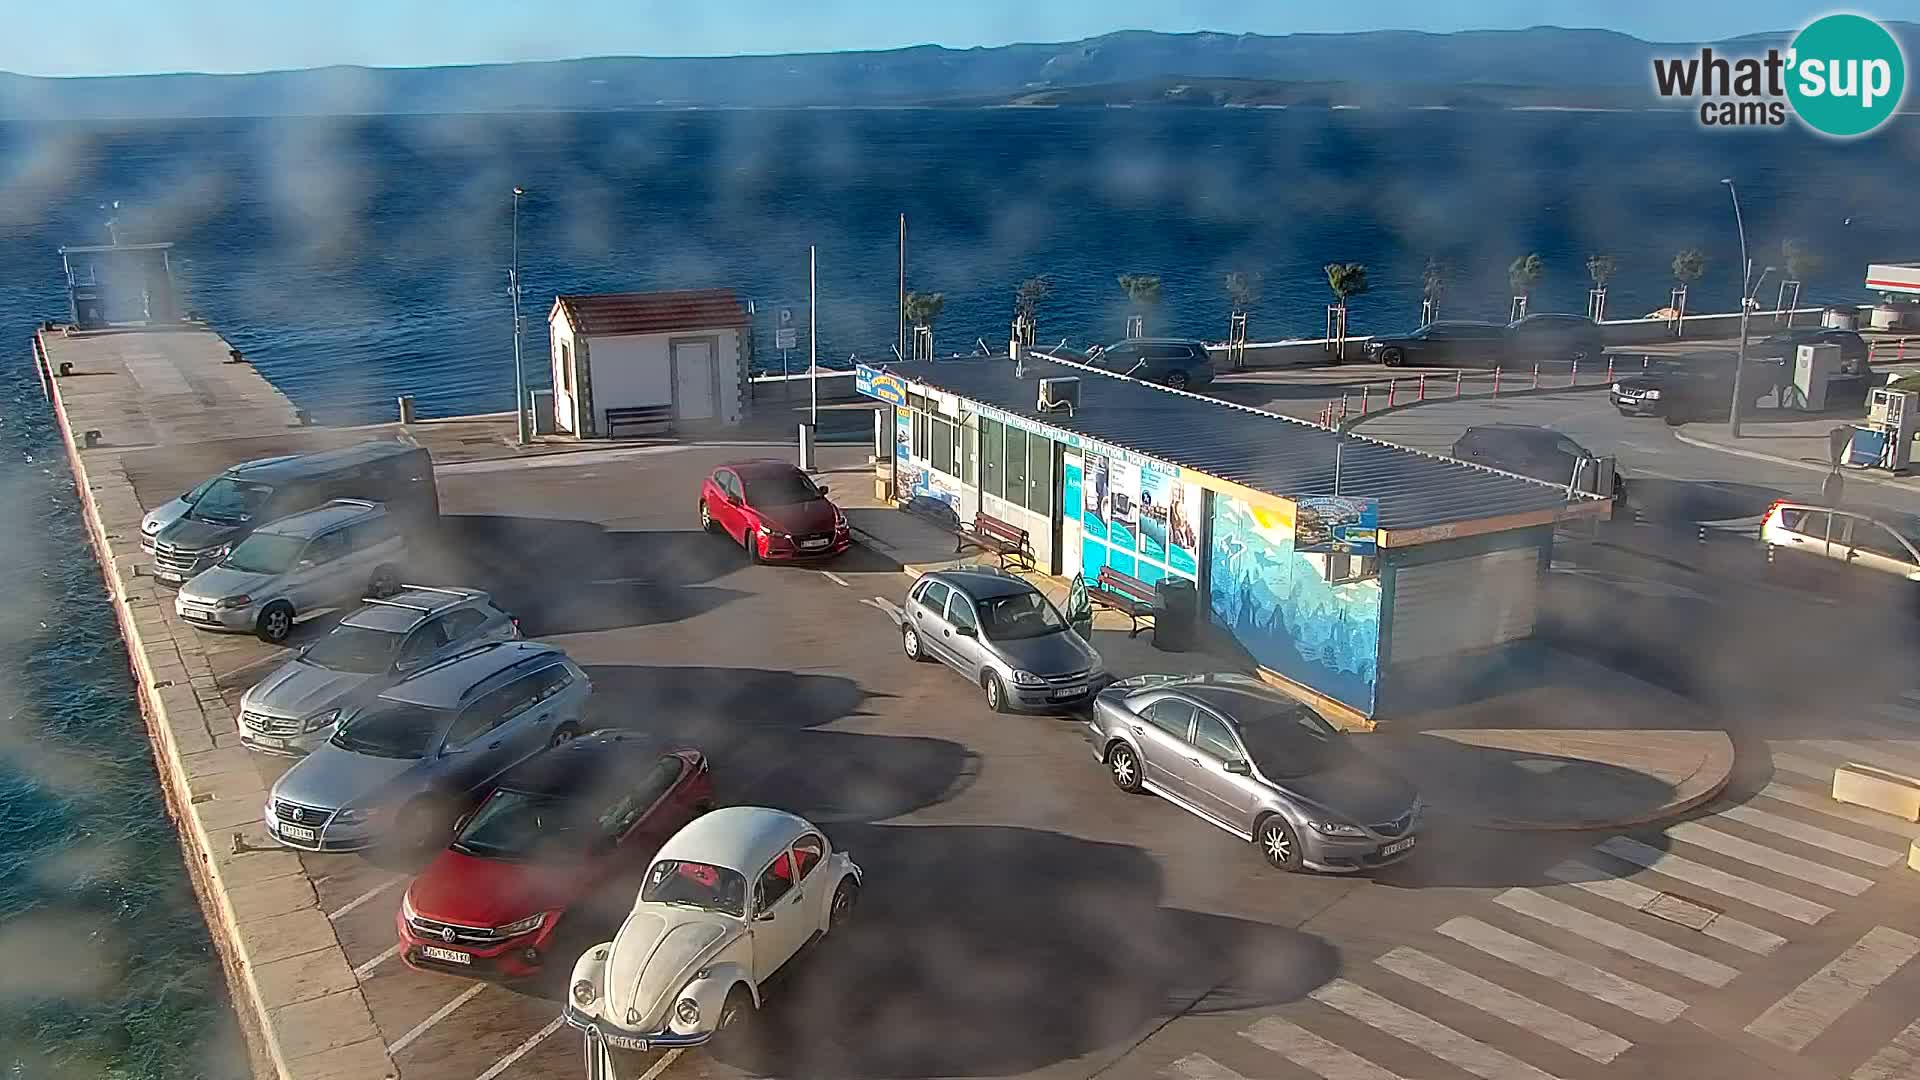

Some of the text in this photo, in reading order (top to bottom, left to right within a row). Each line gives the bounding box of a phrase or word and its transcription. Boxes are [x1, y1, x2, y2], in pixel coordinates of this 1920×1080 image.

[781, 309, 791, 321] P
[1127, 453, 1149, 466] TICKET
[1151, 461, 1176, 475] OFFICE
